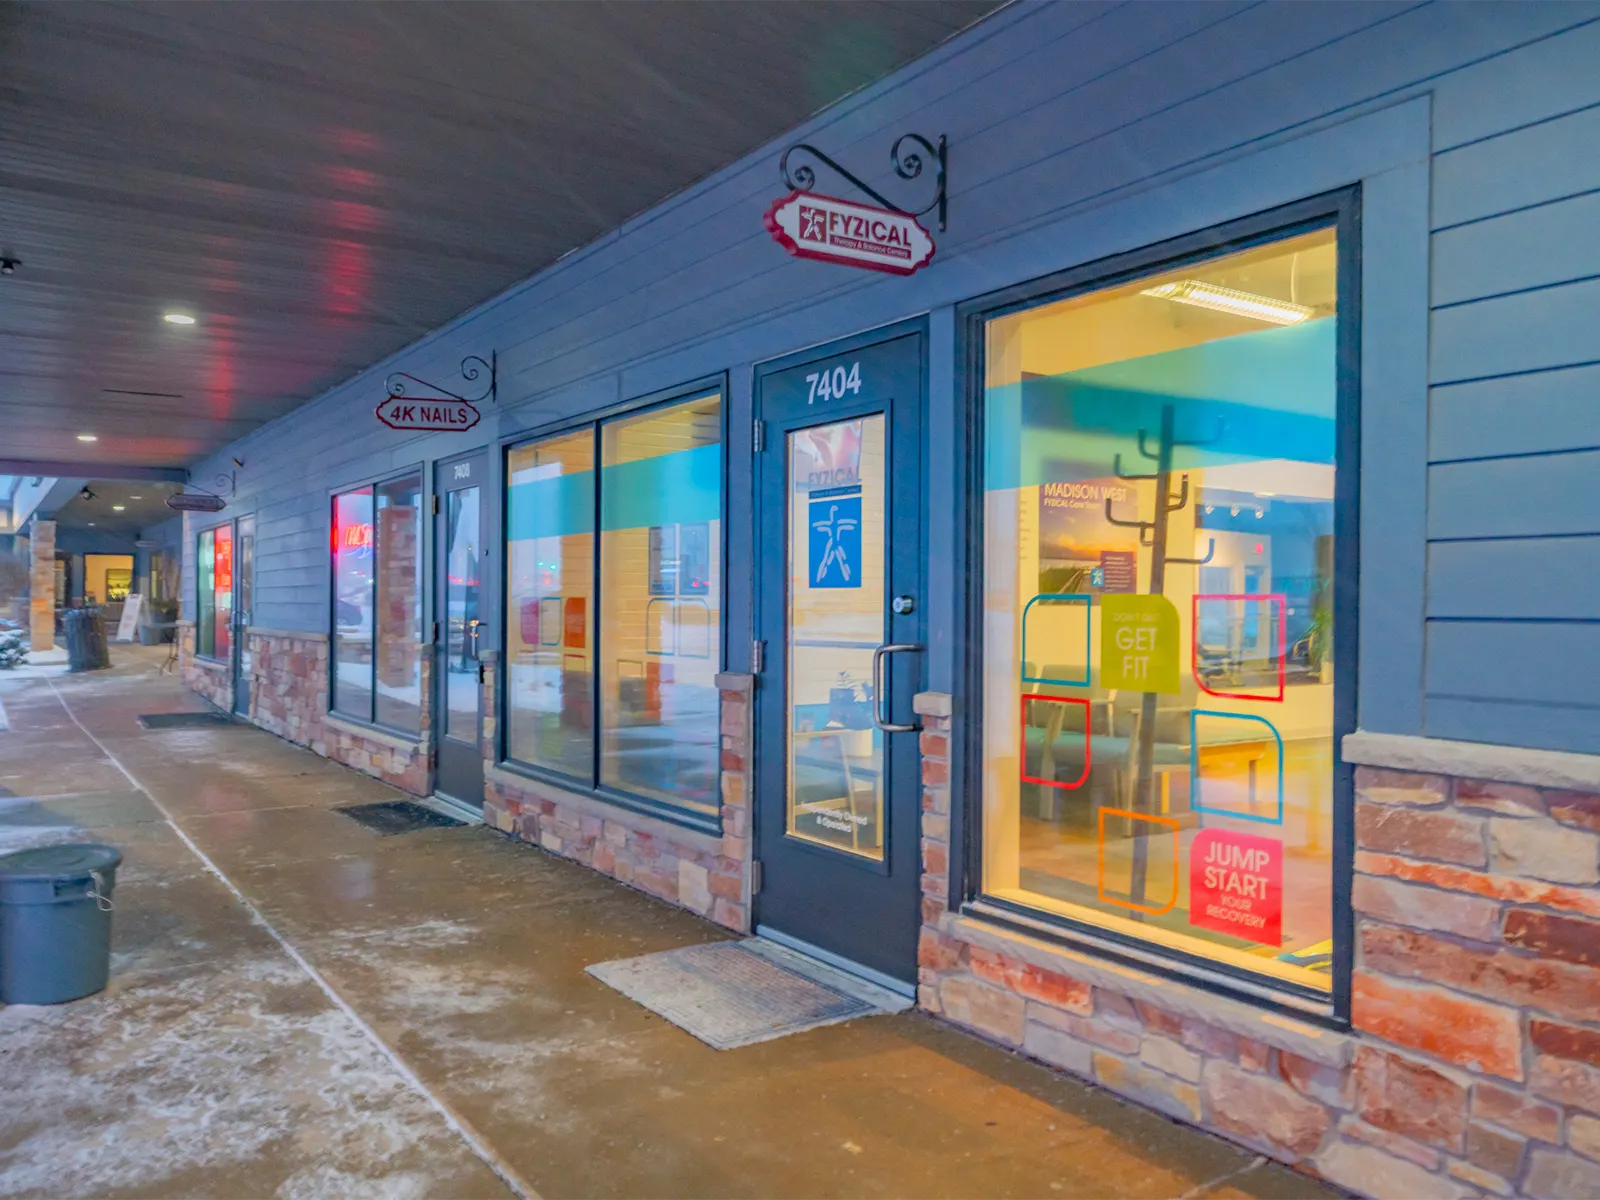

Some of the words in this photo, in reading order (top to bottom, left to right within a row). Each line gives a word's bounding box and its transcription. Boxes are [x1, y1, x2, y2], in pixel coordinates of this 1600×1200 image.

[829, 211, 912, 247] FYZICAL
[834, 237, 857, 249] Therapy
[863, 243, 886, 254] Balance
[806, 362, 862, 405] 7404
[390, 406, 415, 422] 4K
[420, 407, 468, 424] NAILS
[1044, 483, 1098, 500] MADISON
[1101, 487, 1127, 502] WEST
[1115, 627, 1157, 651] GET
[1122, 656, 1150, 679] FIT
[1204, 841, 1270, 872] JUMP
[1204, 865, 1269, 900] START
[1222, 894, 1252, 911] YOUR
[1206, 904, 1266, 928] RECOVERY
